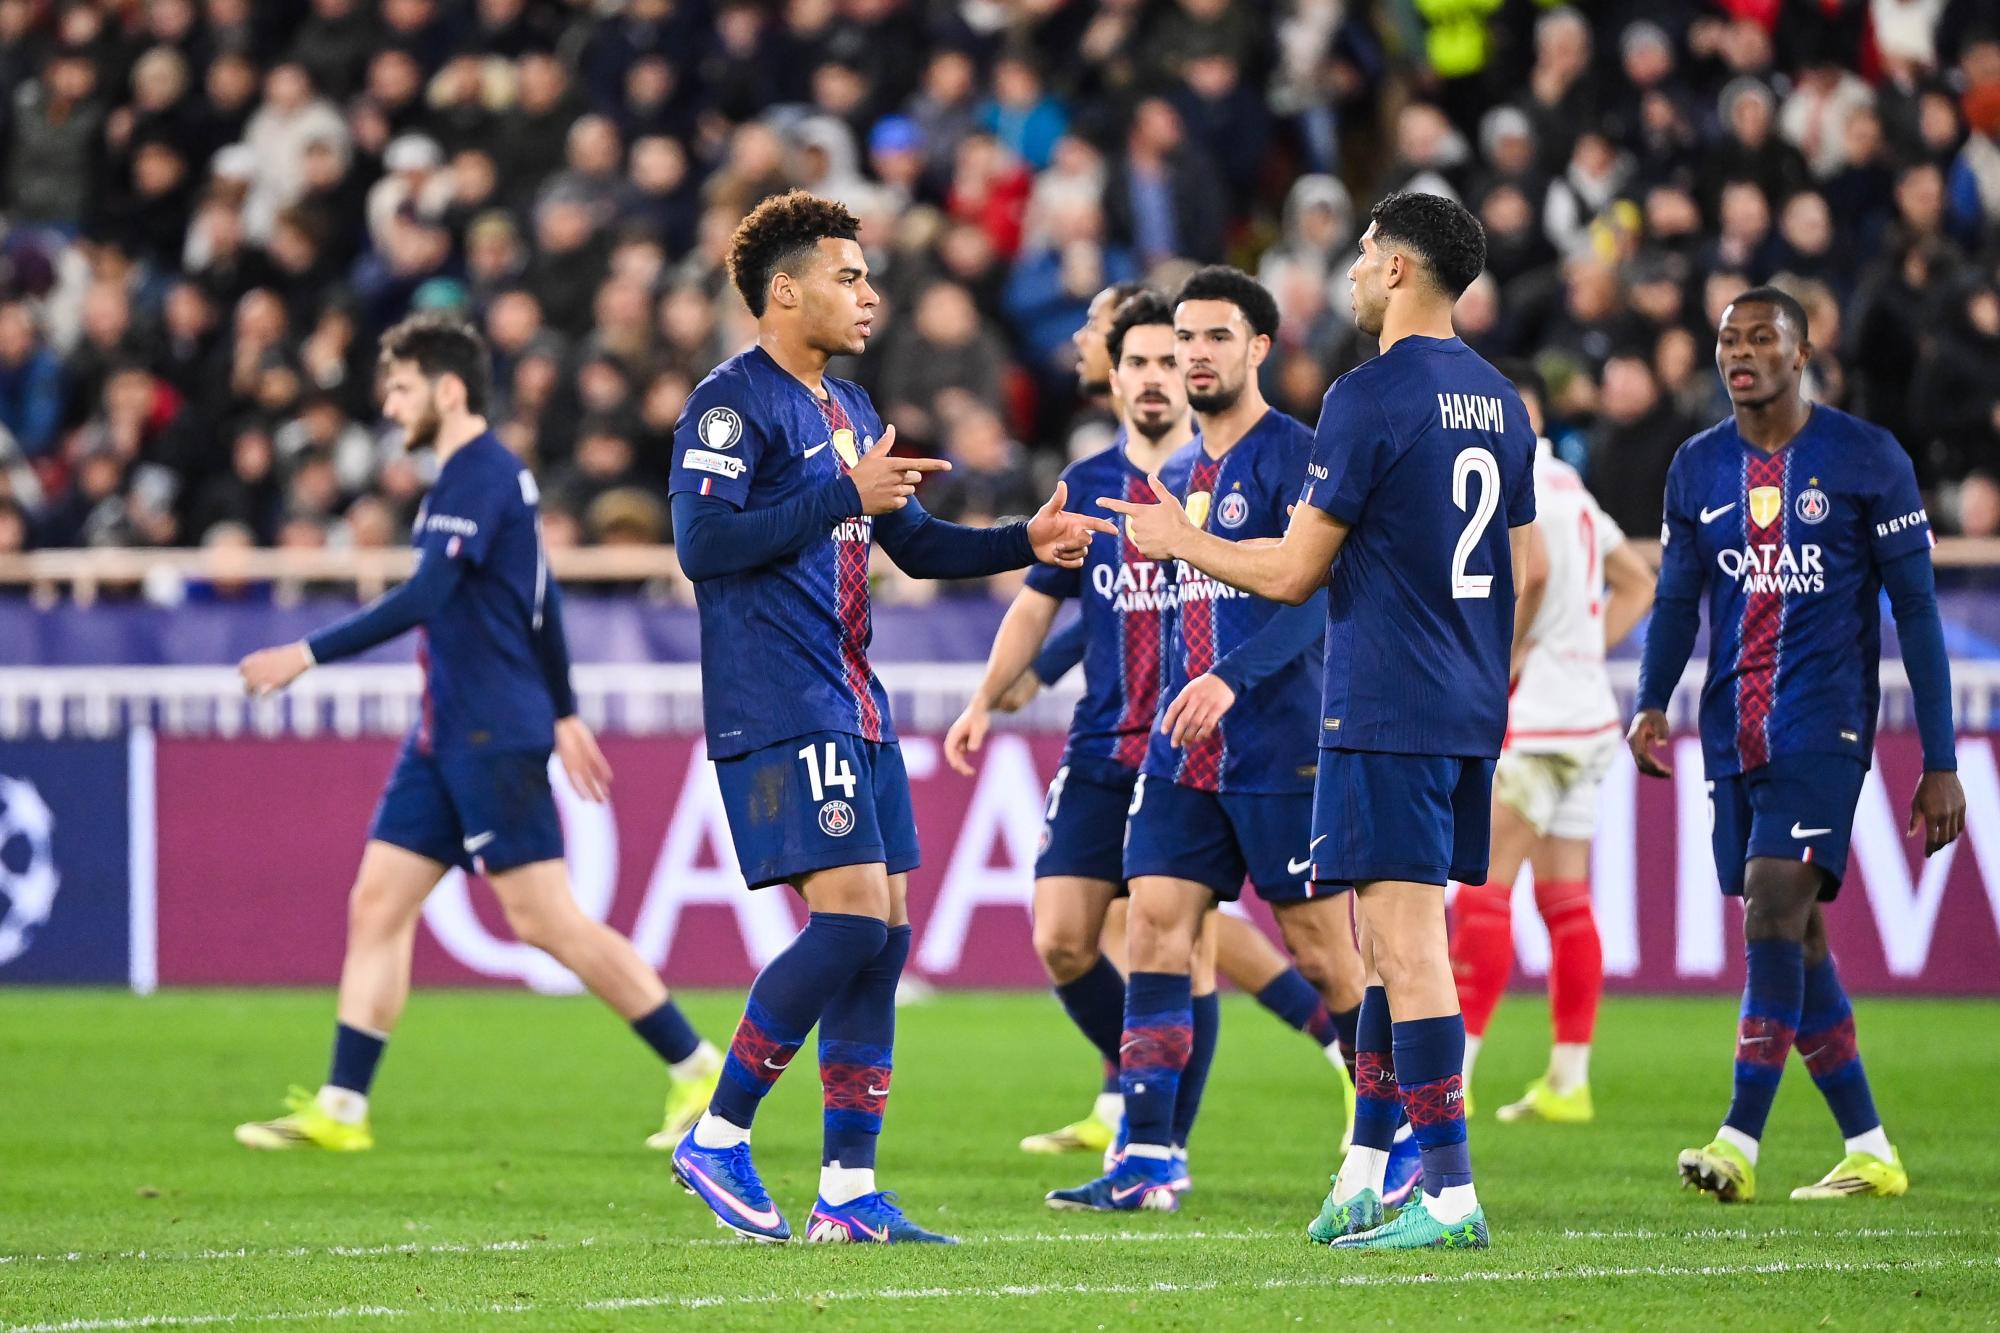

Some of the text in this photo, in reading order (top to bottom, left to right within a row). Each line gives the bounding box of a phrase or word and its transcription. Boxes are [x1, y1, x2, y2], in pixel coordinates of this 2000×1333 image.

[1437, 393, 1504, 434] HAKIMI
[831, 522, 871, 544] AIRW
[1452, 446, 1500, 599] 2
[1876, 508, 1928, 538] BEYON
[1717, 543, 1824, 582] QATAR
[1092, 561, 1178, 601] QATA
[1178, 579, 1251, 602] AIRWAY
[1742, 573, 1825, 594] AIRWAYS
[1112, 590, 1178, 612] AIRWA
[799, 742, 857, 802] 14
